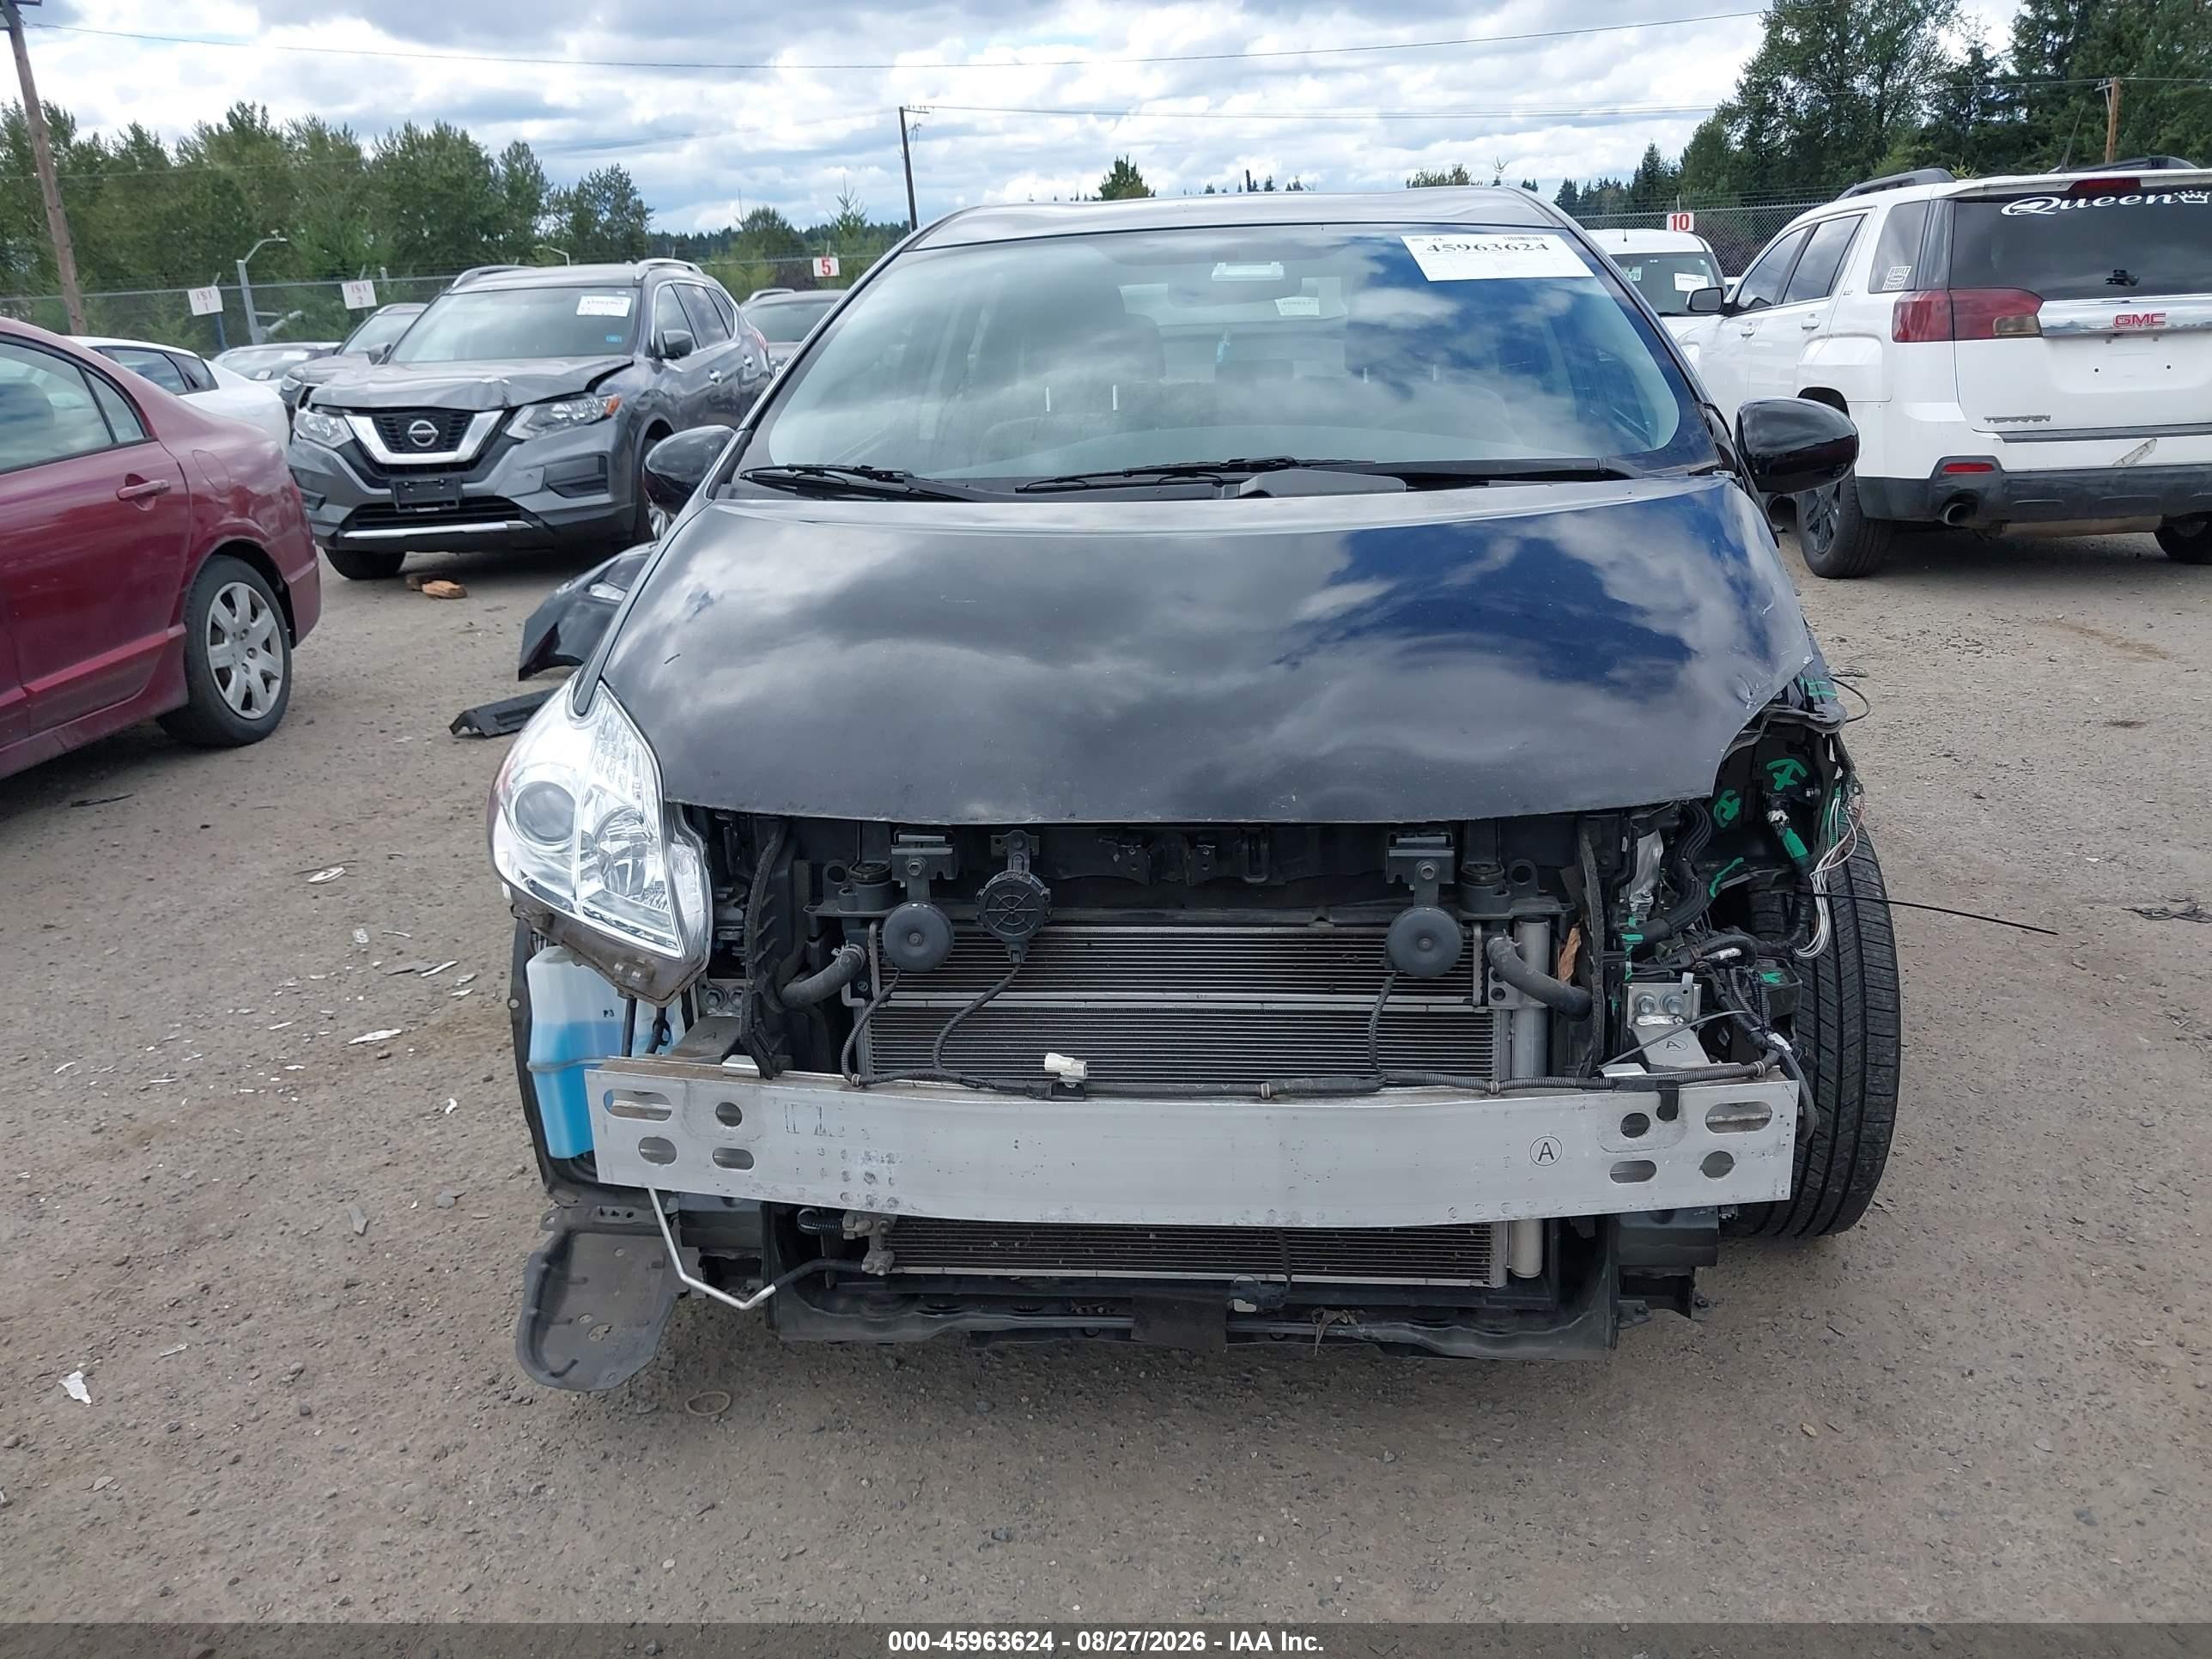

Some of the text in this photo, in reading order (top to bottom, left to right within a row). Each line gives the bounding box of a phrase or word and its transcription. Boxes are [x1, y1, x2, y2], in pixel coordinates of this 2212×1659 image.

[2001, 194, 2178, 216] Queen
[1671, 214, 1690, 232] 10
[1426, 243, 1550, 252] 45963624
[821, 258, 831, 276] 5
[2113, 313, 2166, 326] GMC
[1537, 1141, 1555, 1162] A
